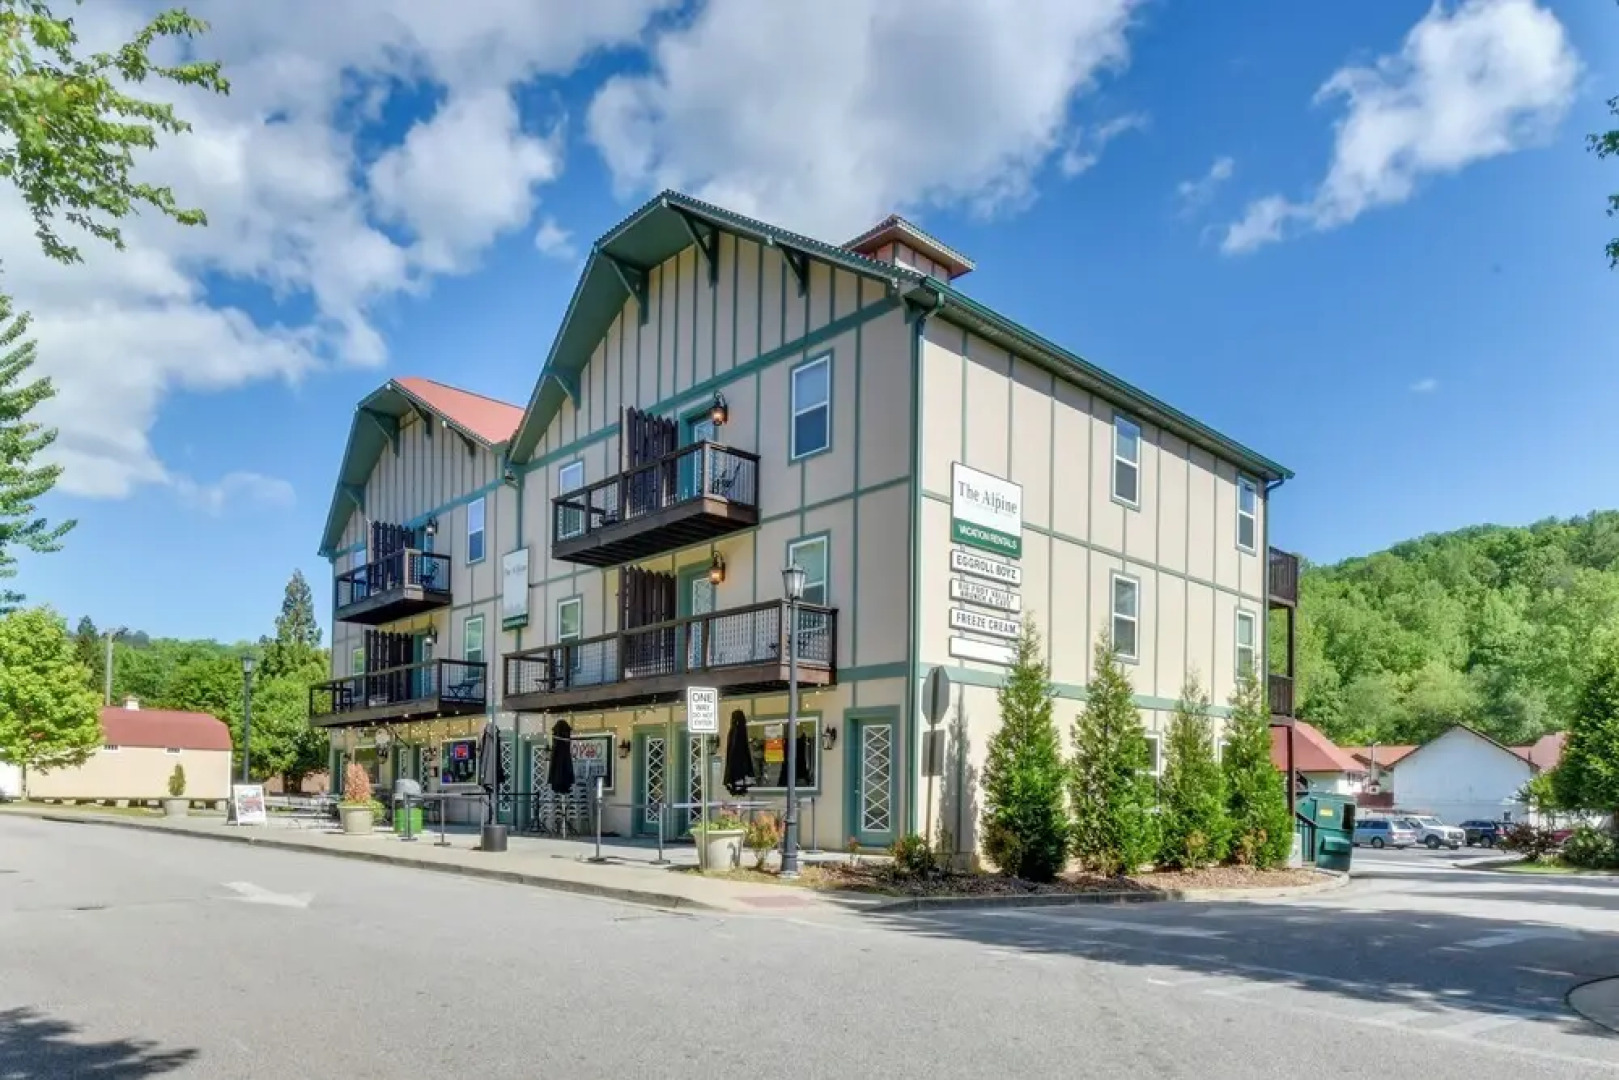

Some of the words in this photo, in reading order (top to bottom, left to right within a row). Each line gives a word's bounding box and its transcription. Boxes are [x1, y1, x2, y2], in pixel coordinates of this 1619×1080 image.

[958, 481, 979, 502] The
[982, 490, 1017, 514] Alpine
[957, 554, 994, 573] EGGROLL
[996, 564, 1016, 579] BOYZ
[957, 611, 985, 629] FREEZE
[988, 619, 1016, 633] CREAM
[693, 693, 713, 703] ONE
